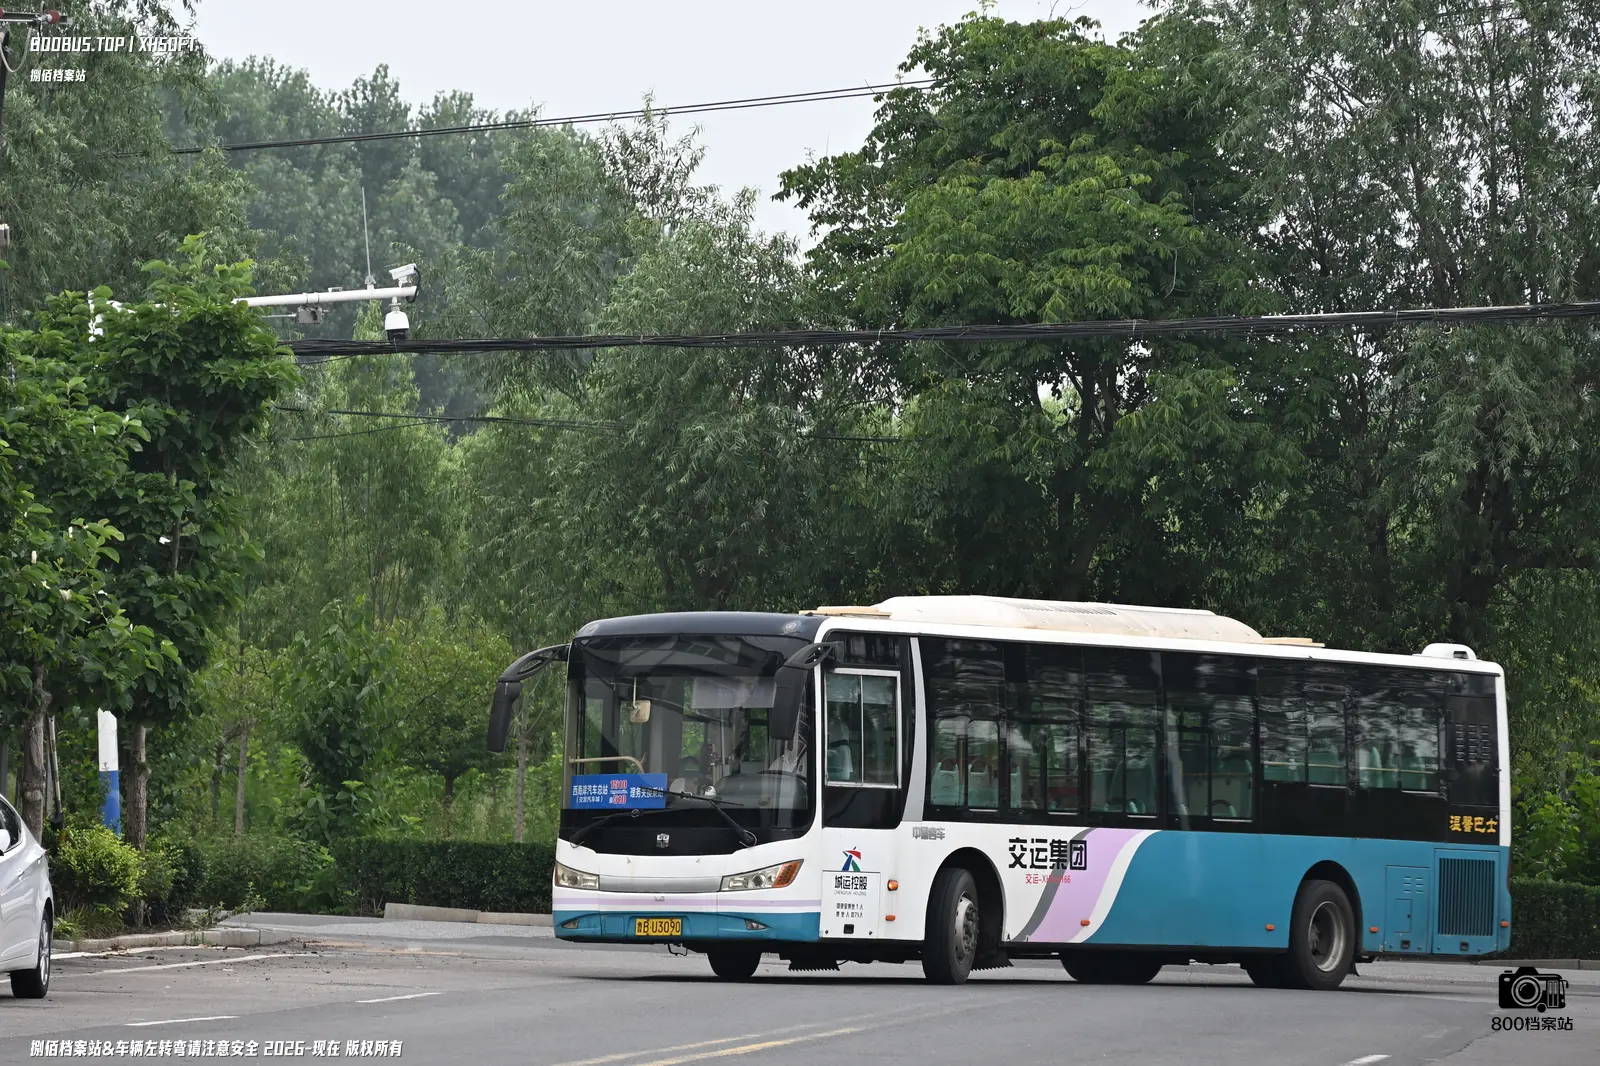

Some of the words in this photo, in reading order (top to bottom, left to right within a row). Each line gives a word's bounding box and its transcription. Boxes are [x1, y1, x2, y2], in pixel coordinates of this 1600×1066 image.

[1450, 816, 1495, 832] 温馨巴士
[1009, 837, 1087, 870] 交运集团
[835, 875, 867, 890] 城运控股
